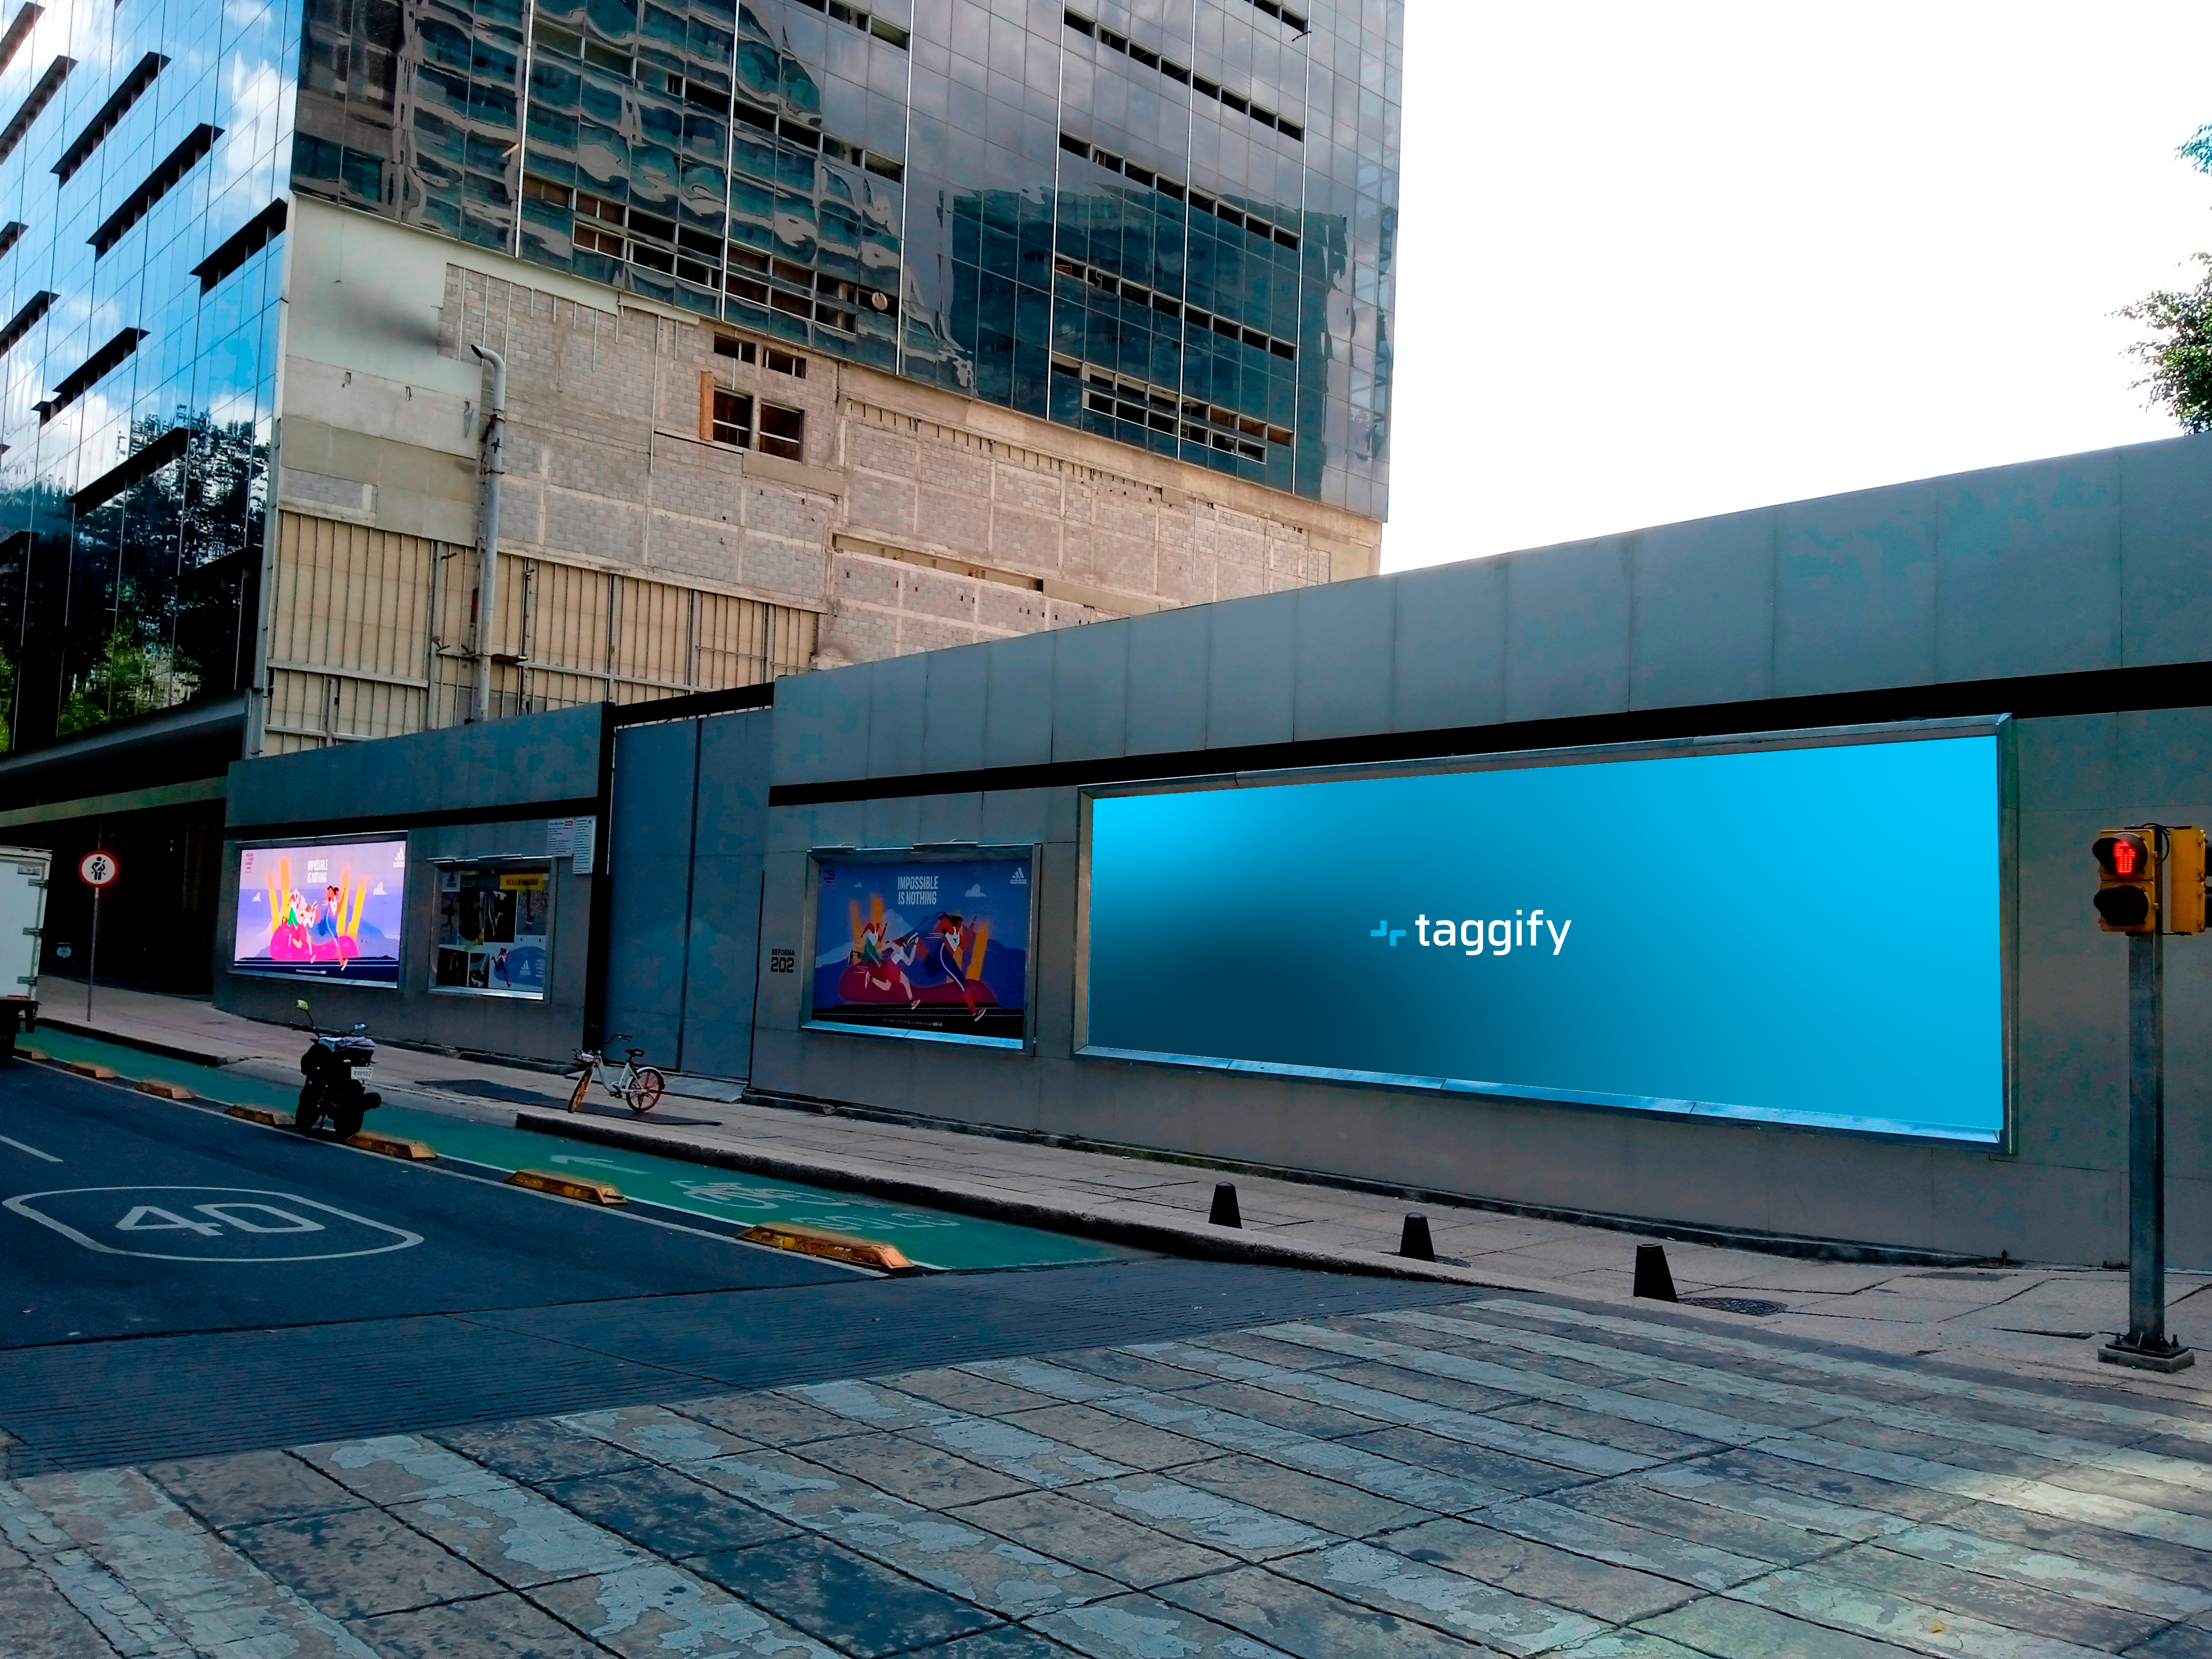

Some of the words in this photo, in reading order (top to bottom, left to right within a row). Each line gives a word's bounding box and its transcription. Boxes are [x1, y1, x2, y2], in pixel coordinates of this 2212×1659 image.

[898, 876, 939, 890] IMPOSSIBLE
[898, 891, 905, 905] IS
[906, 891, 937, 905] NOTHING
[1415, 909, 1572, 956] taggify
[770, 956, 794, 973] 202
[115, 1203, 325, 1236] 40
